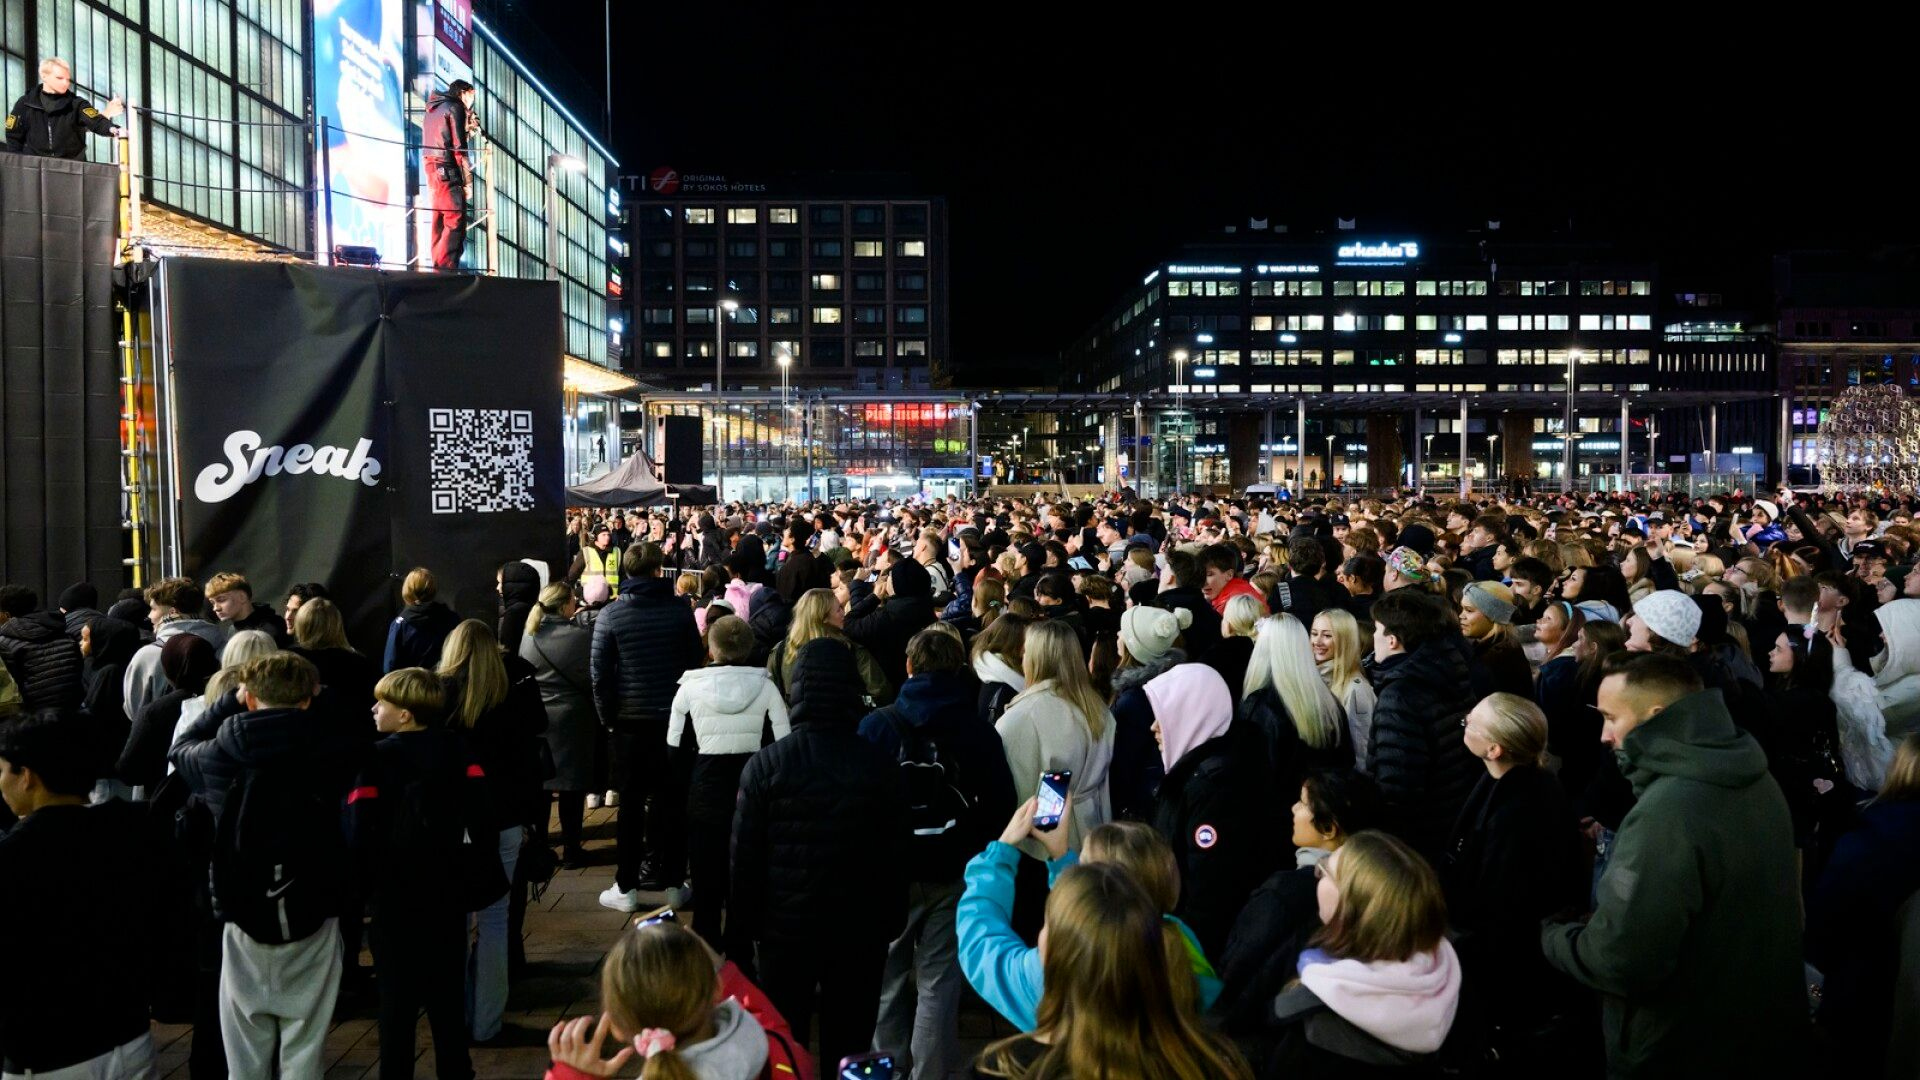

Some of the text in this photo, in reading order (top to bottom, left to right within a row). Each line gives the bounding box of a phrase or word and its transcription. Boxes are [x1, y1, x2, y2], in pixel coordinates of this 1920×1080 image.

[682, 174, 726, 182] ORIGINAL
[682, 183, 766, 192] BY SOKOS HOTELS
[1269, 265, 1320, 273] WARNER MUSIC
[194, 429, 382, 503] Sneak
